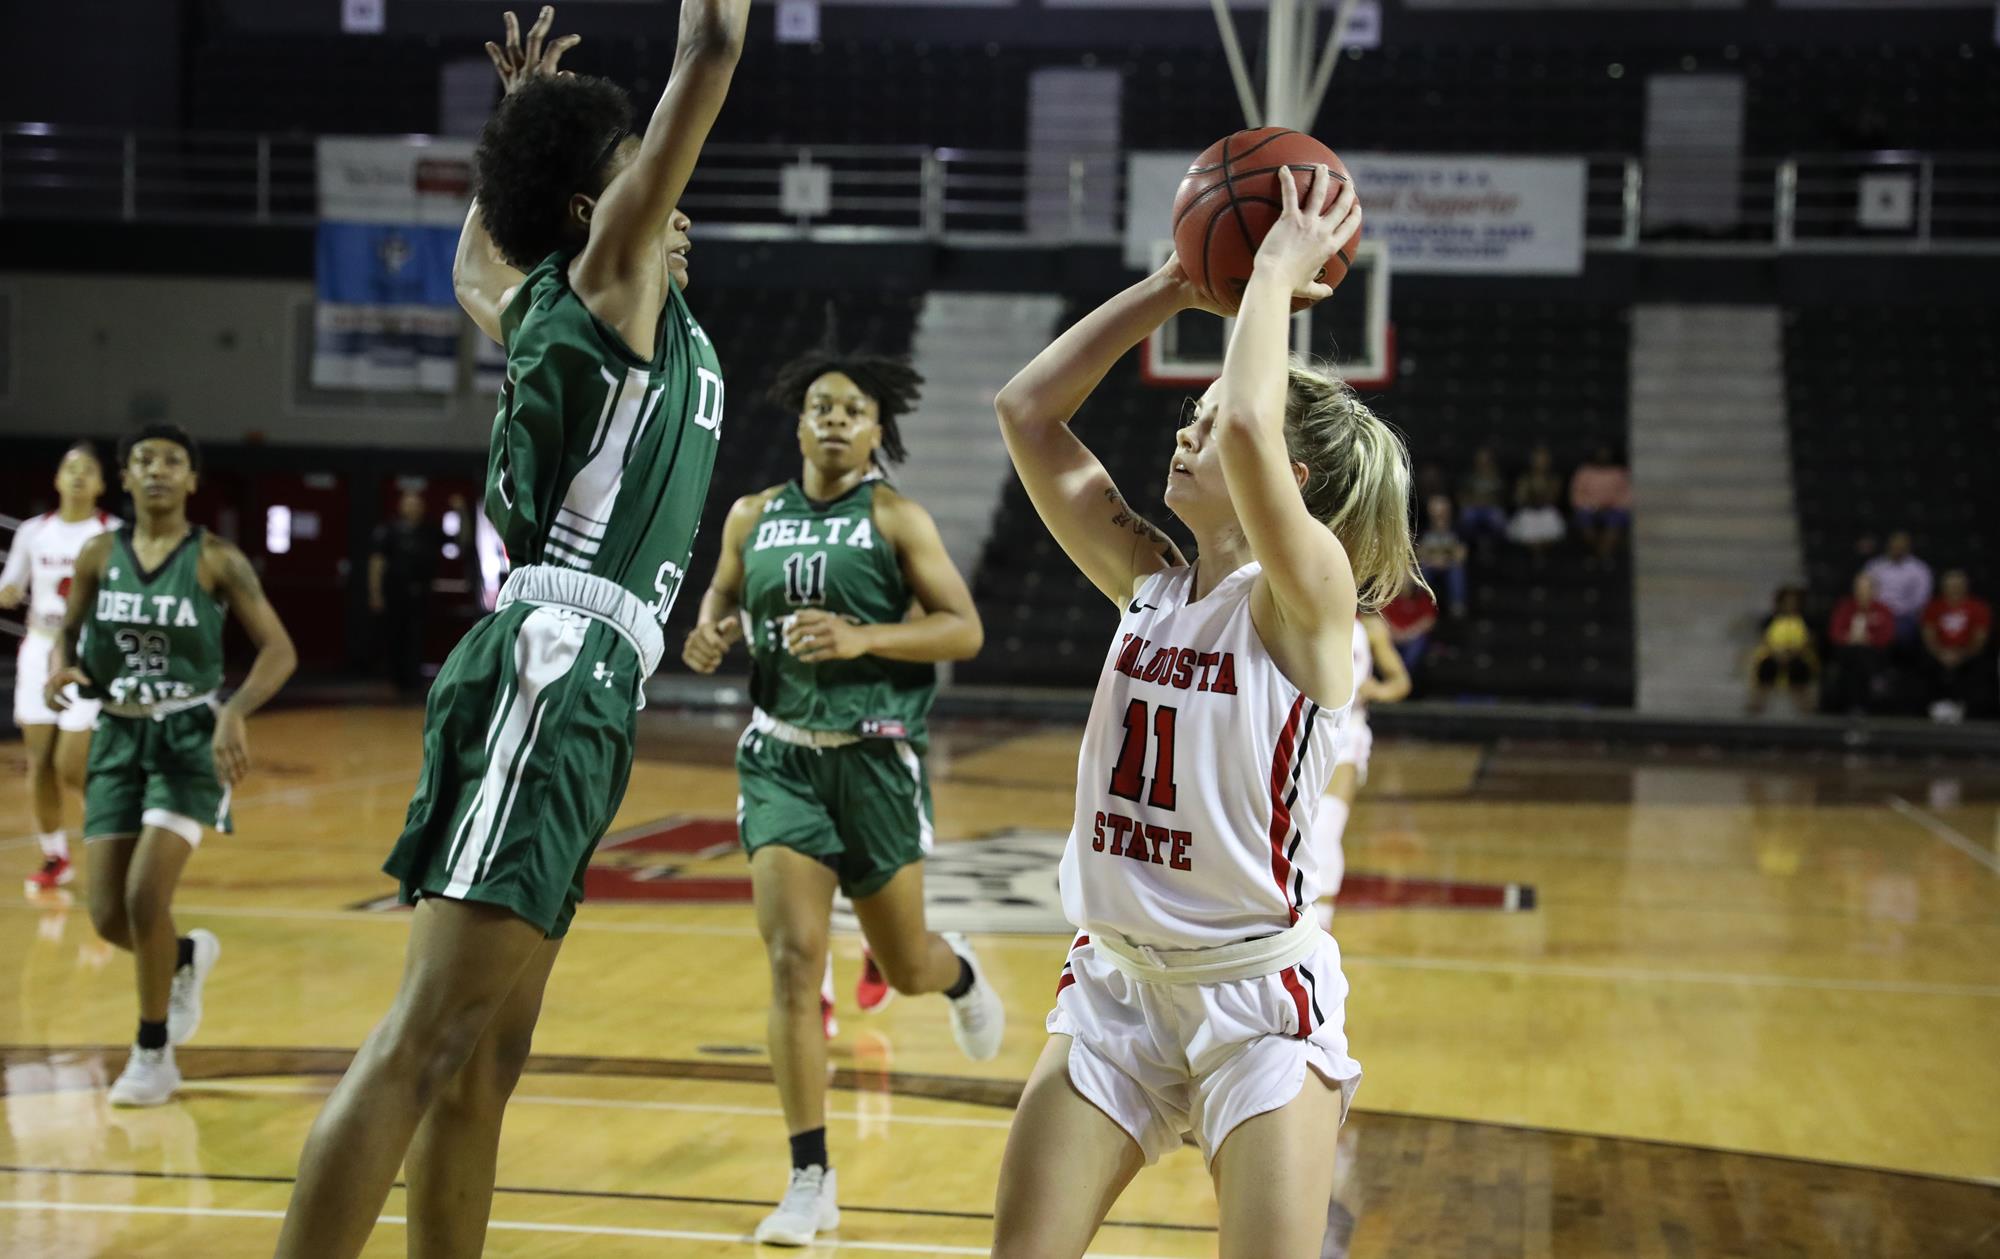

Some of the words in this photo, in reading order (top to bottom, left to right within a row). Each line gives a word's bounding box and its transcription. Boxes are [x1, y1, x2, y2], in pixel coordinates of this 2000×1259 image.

[754, 518, 873, 550] DELTA
[784, 552, 827, 605] 11
[97, 590, 198, 626] DELTA
[1109, 698, 1177, 811] 11
[1093, 811, 1192, 871] STATE
